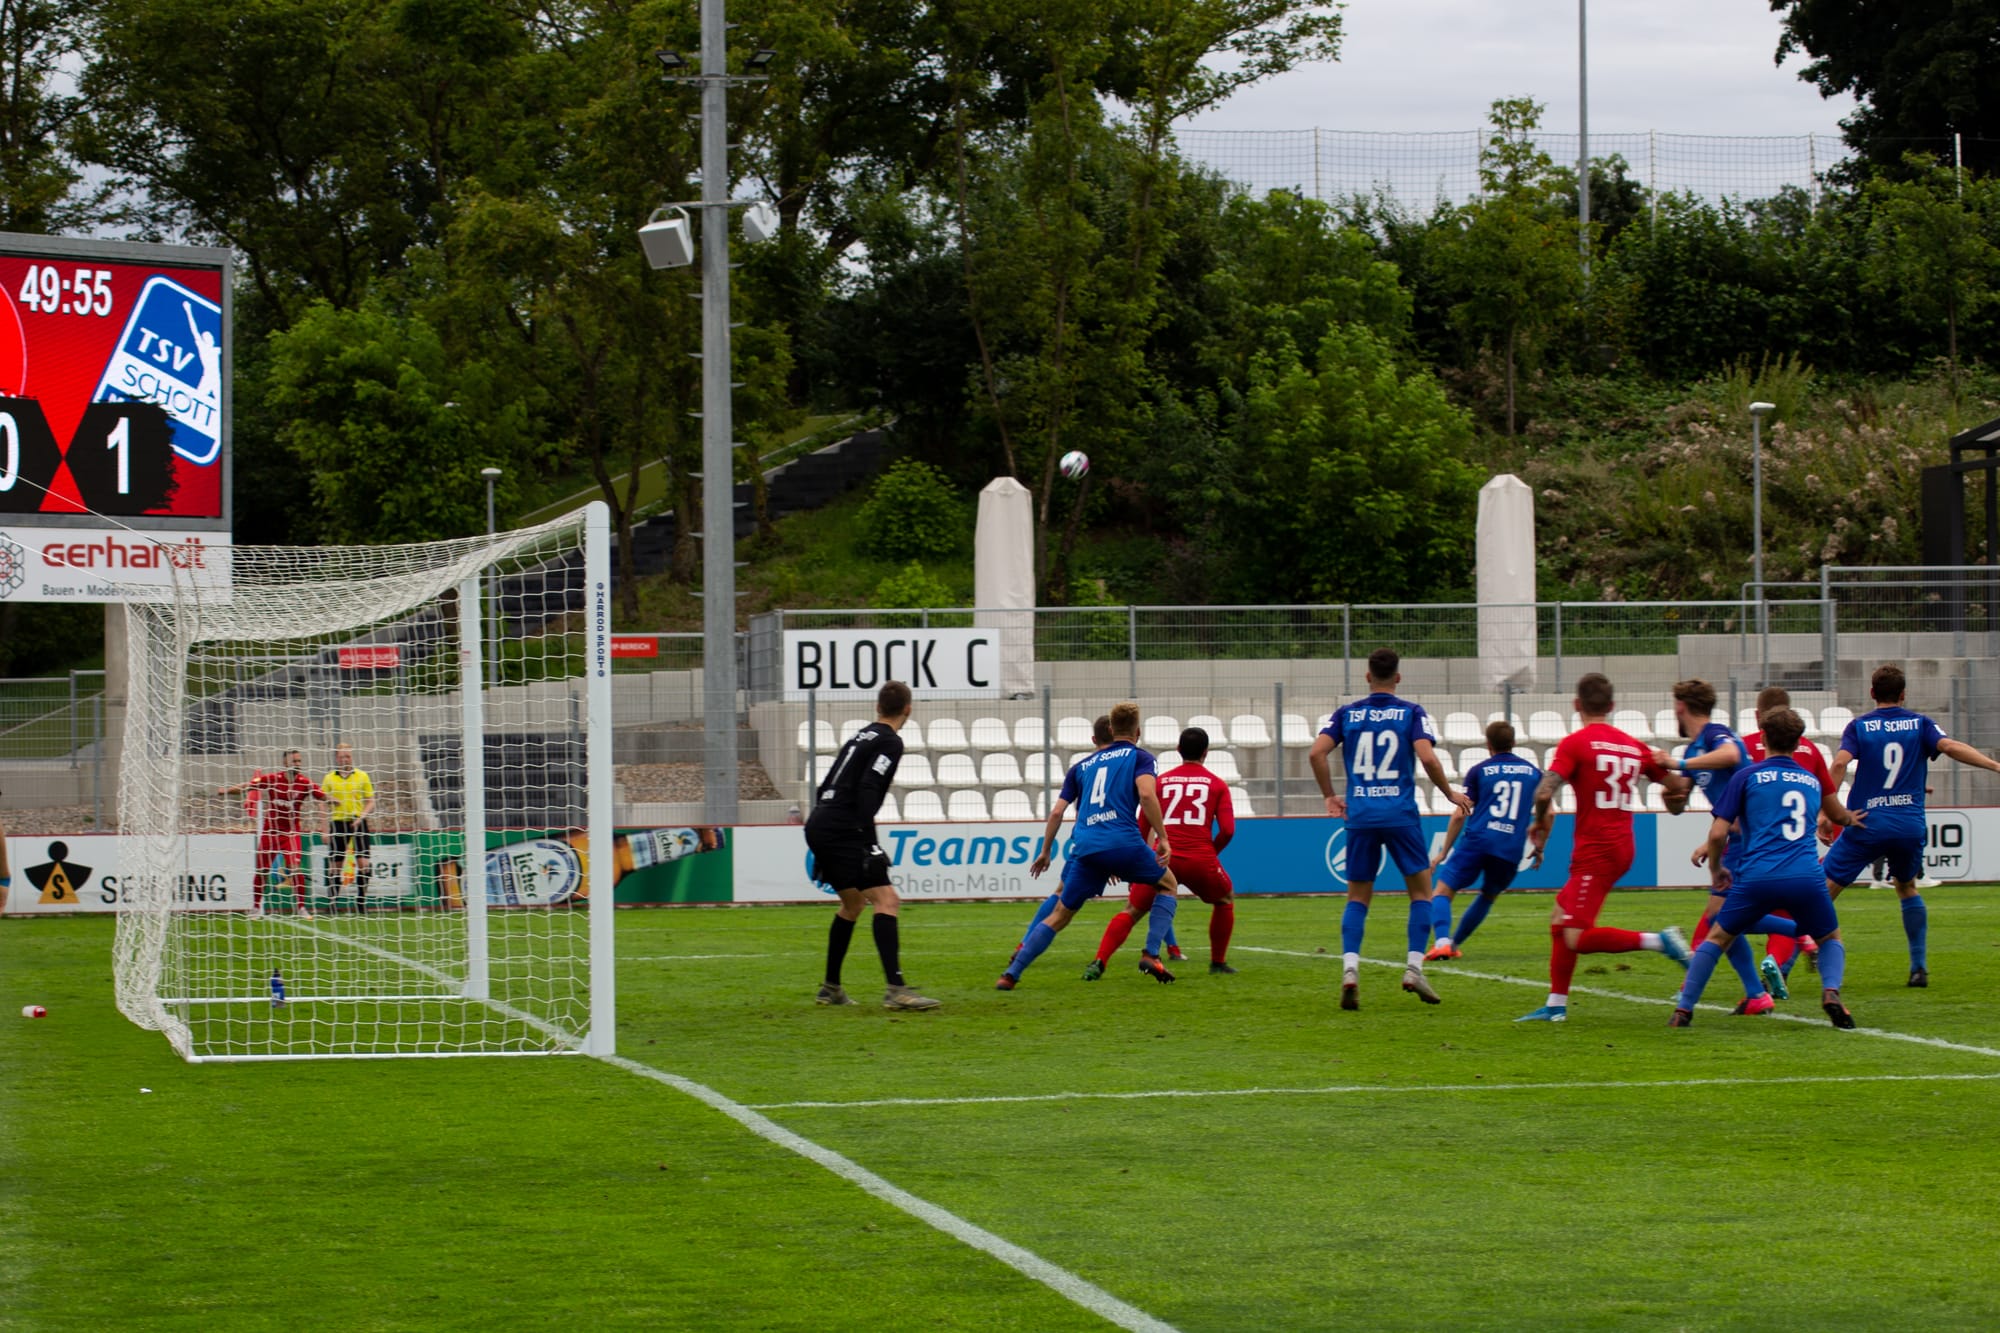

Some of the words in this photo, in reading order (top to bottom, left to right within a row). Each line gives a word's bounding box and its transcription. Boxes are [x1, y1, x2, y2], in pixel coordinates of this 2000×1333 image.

[20, 265, 113, 316] 49:55
[138, 327, 195, 372] TSV
[122, 364, 216, 426] SCHOTT
[106, 416, 129, 494] 1
[42, 584, 75, 597] Bauen
[596, 592, 605, 632] HARROD
[596, 634, 605, 668] SPORT
[797, 640, 938, 689] BLOCK
[967, 639, 989, 687] C
[1349, 709, 1366, 723] TSV
[1369, 708, 1406, 722] SCHOTT
[1863, 720, 1881, 732] TSV
[1884, 718, 1920, 732] SCHOTT
[830, 745, 857, 786] 1
[1100, 747, 1133, 762] SCHOTT
[1353, 730, 1400, 781] 42
[1483, 765, 1499, 777] TSV
[1882, 742, 1904, 789] 9
[1090, 766, 1108, 808] 4
[1489, 780, 1523, 821] 31
[1595, 754, 1641, 812] 33
[1754, 770, 1778, 783] TSV
[1781, 771, 1820, 793] SCHOTT
[1867, 794, 1914, 810] RIPPLINGER
[1162, 783, 1210, 826] 23
[1782, 790, 1806, 841] 3
[889, 830, 1074, 866] Teamspo
[512, 852, 538, 899] Licher
[892, 873, 1021, 894] Rhein-Main
